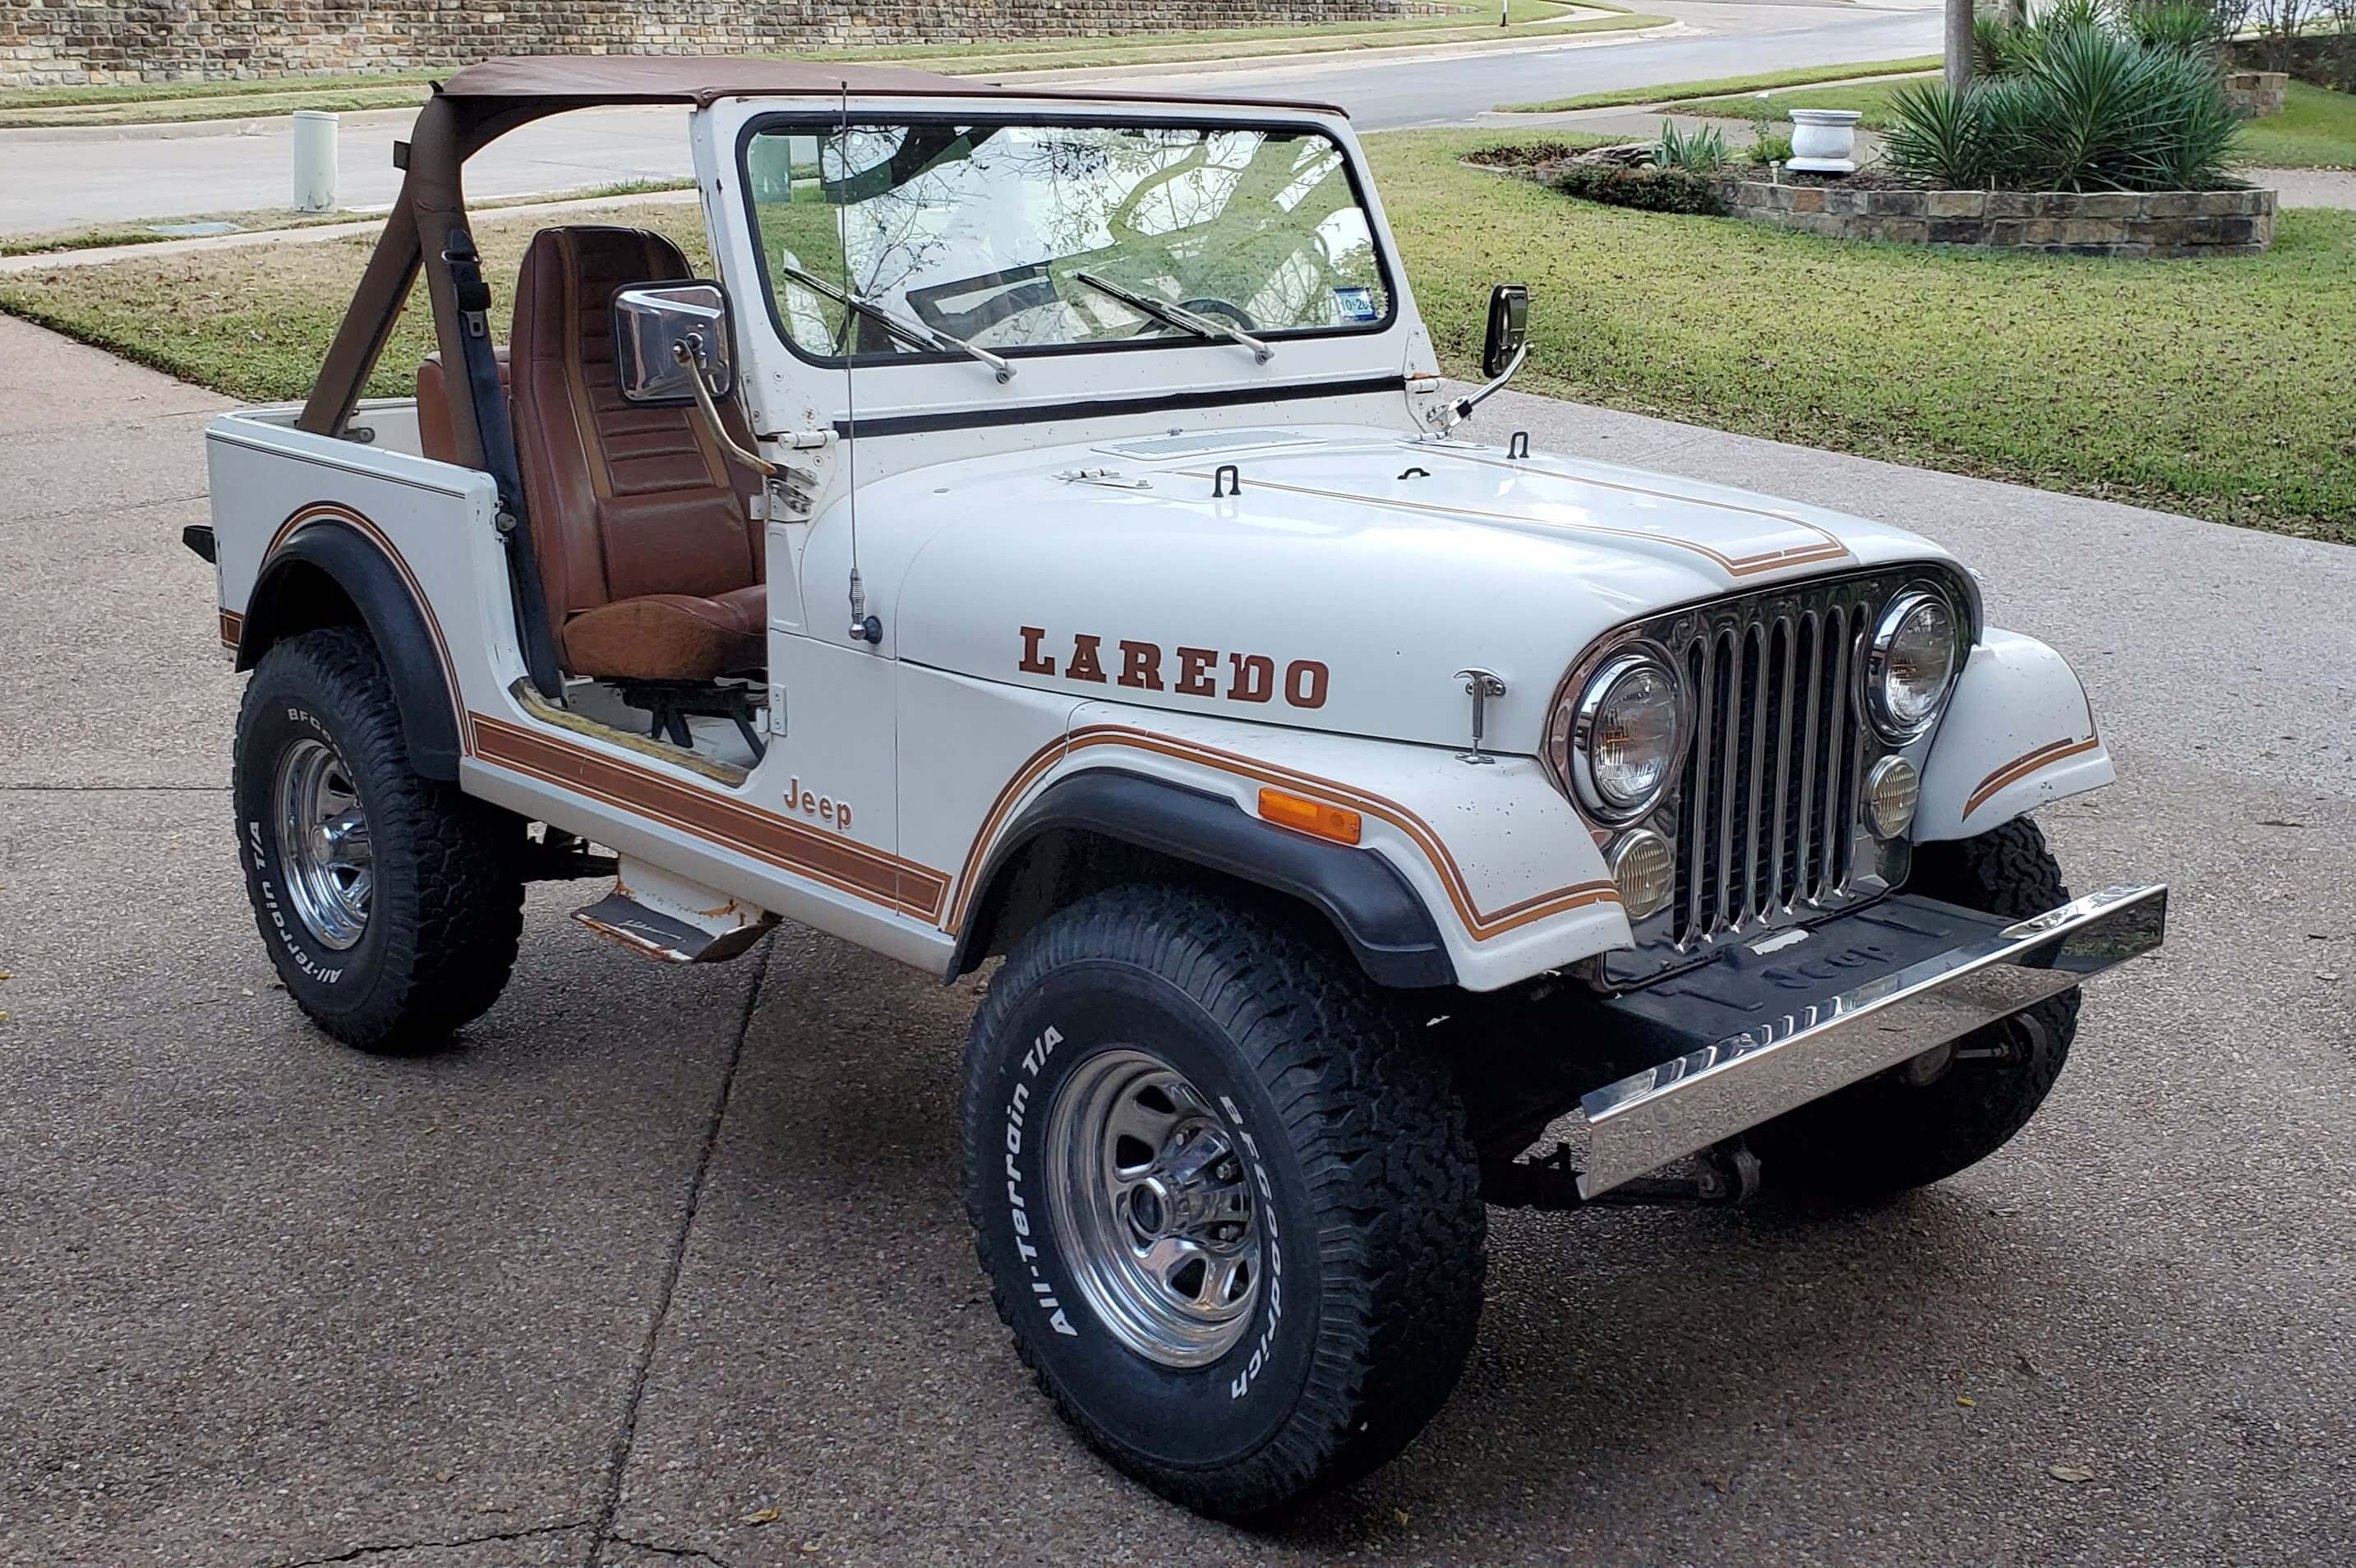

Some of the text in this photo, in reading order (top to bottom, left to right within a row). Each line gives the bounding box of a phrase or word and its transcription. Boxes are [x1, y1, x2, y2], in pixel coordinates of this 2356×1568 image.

[1019, 625, 1330, 709] LAREDO
[249, 822, 266, 869] T/A
[783, 777, 852, 832] Jeep
[261, 881, 343, 984] All-Terrain
[1006, 1025, 1078, 1336] All-Terrain T/A
[1219, 1095, 1282, 1399] BFGoodrich
